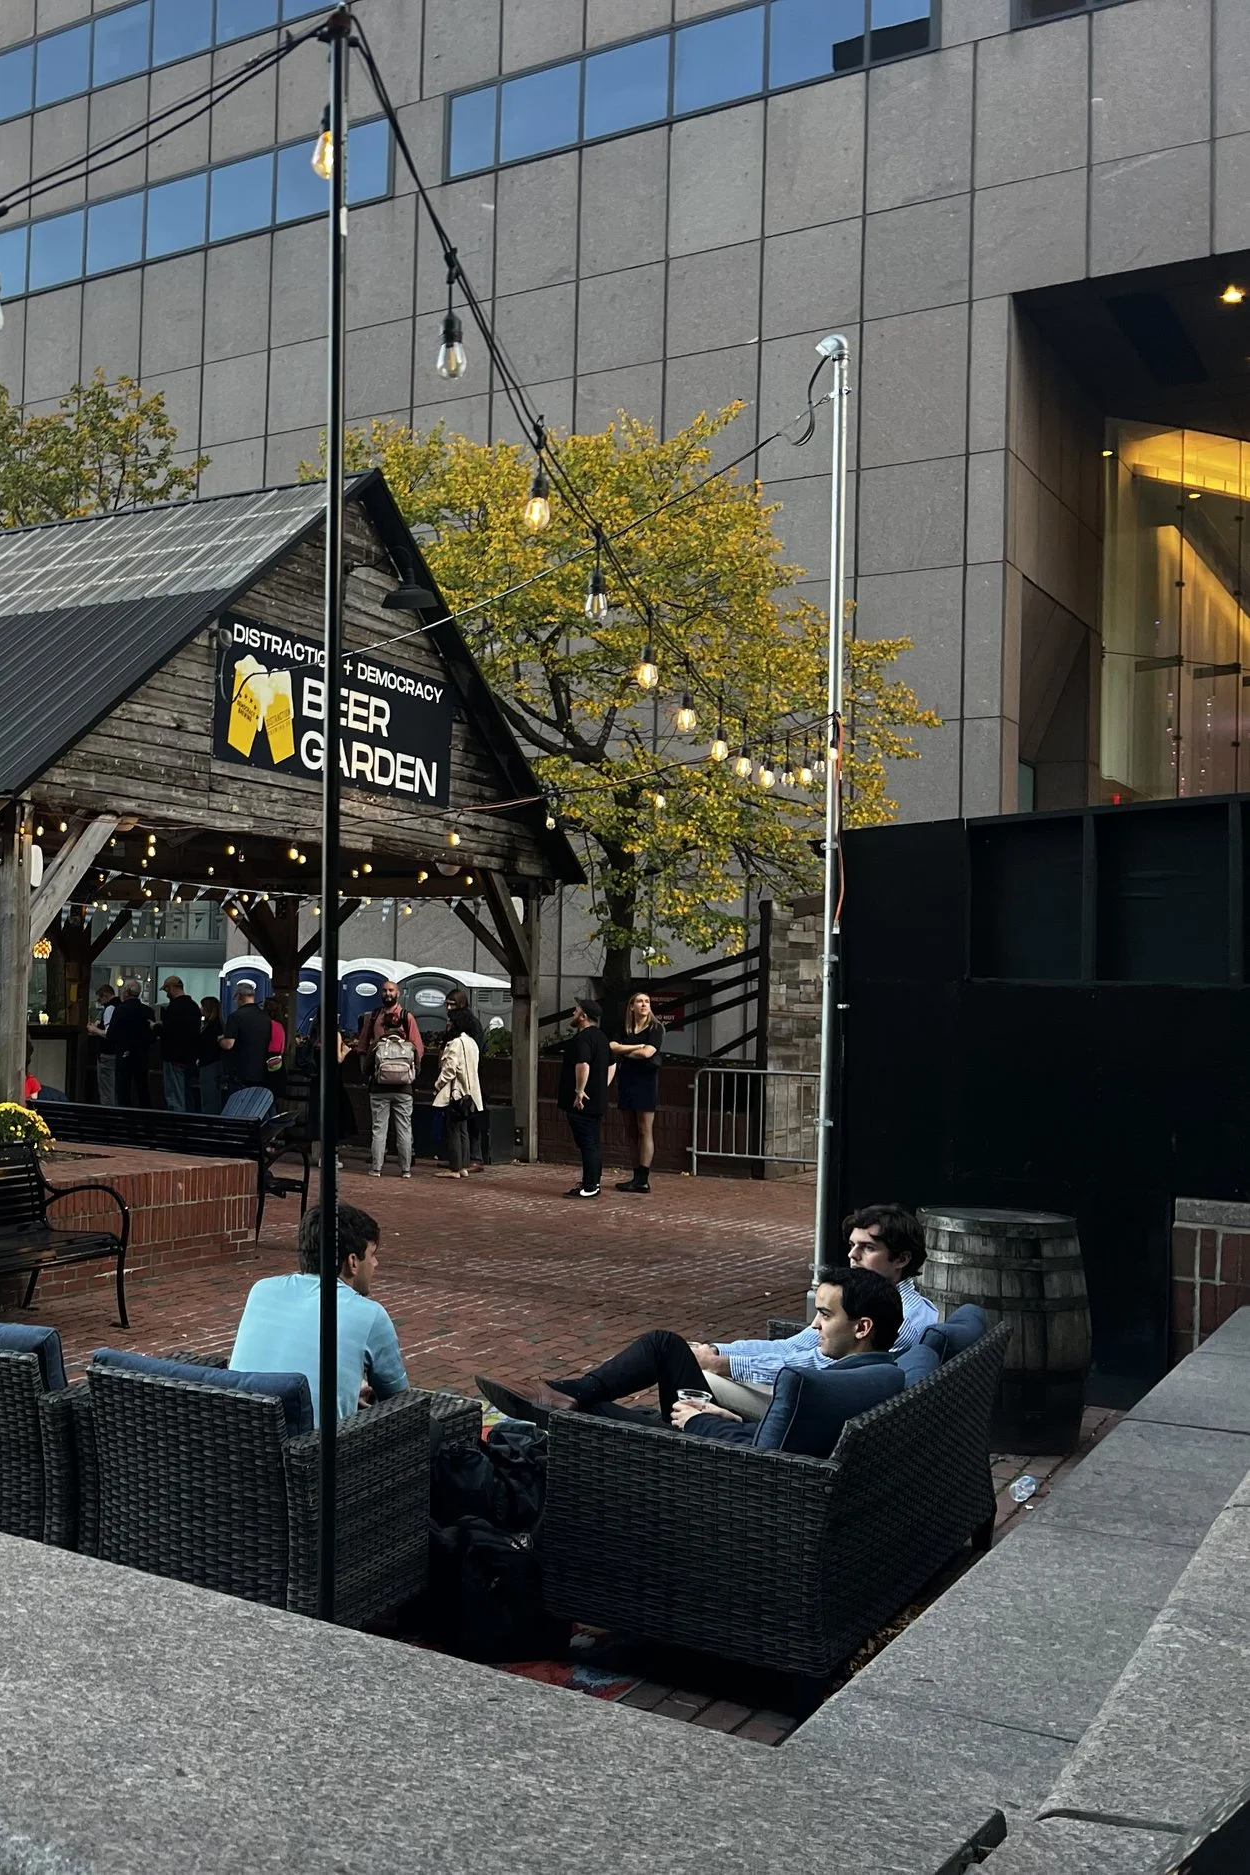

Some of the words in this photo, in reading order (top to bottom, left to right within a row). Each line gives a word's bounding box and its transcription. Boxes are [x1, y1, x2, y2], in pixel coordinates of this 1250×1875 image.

[233, 623, 326, 667] DISTRACTIO
[343, 659, 353, 676] +
[357, 662, 443, 703] DEMOCRACY
